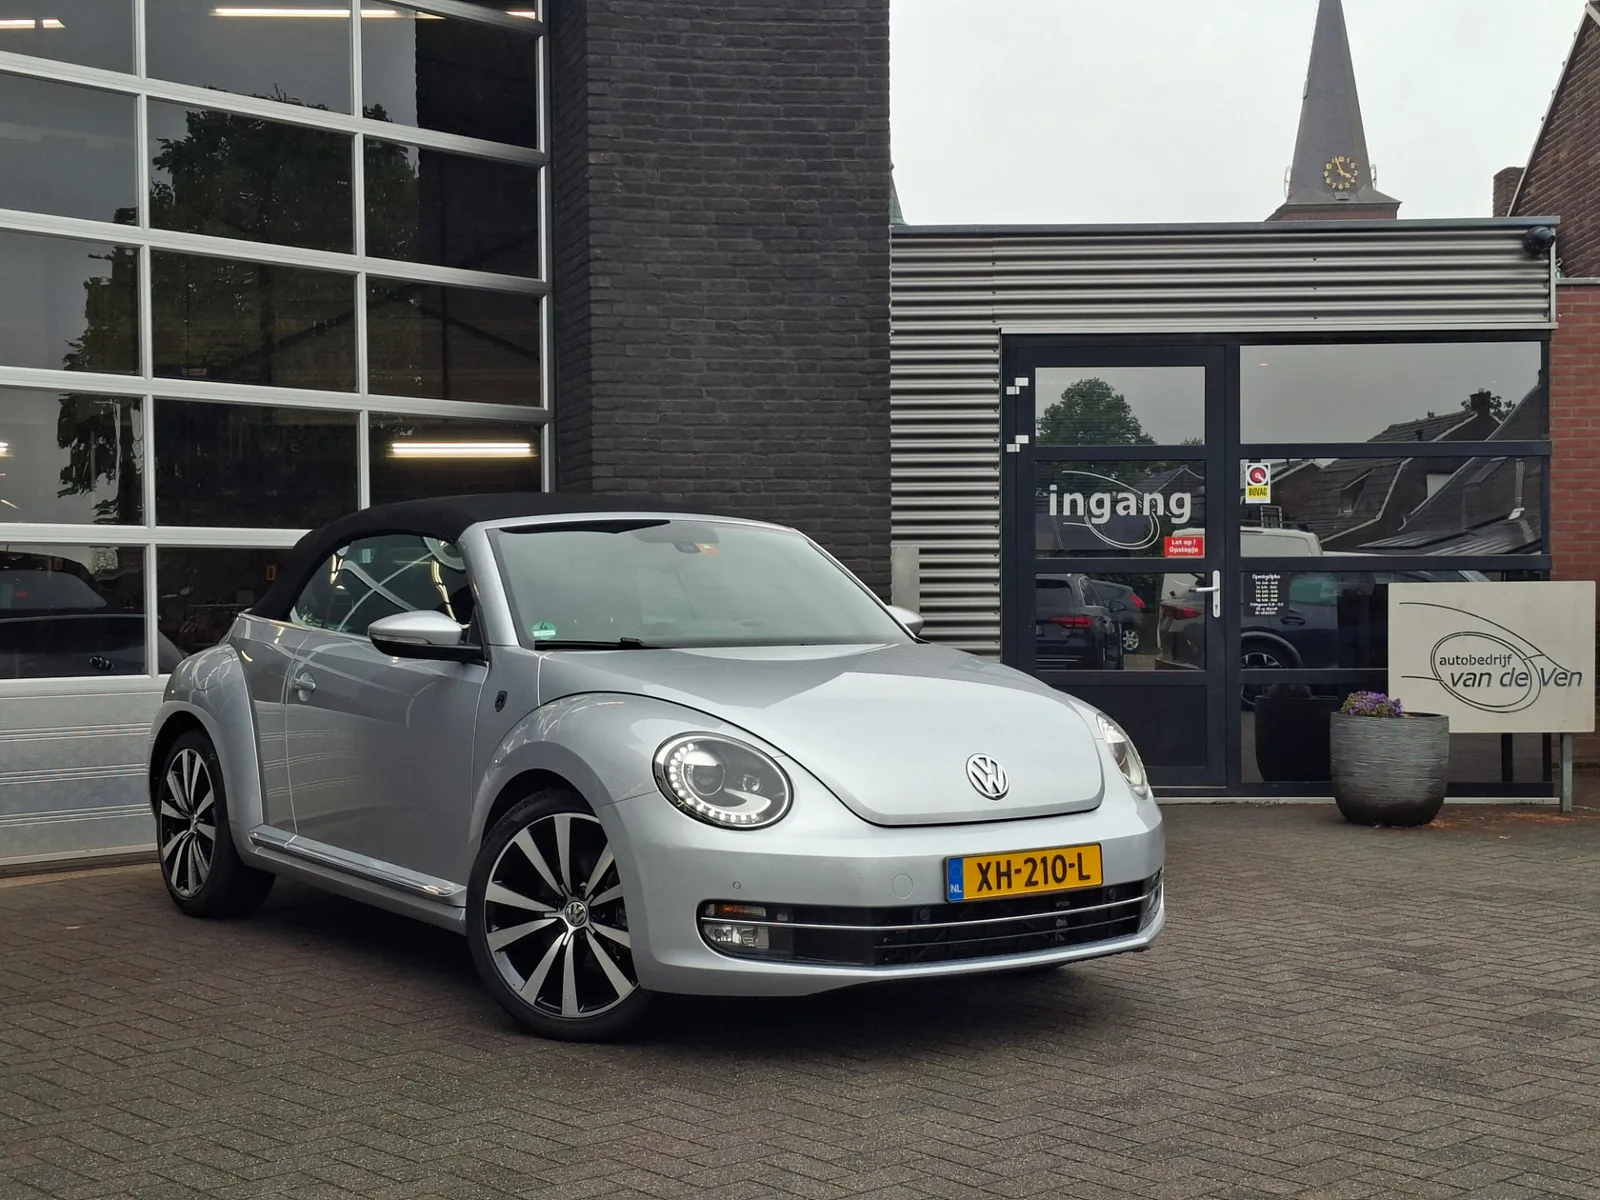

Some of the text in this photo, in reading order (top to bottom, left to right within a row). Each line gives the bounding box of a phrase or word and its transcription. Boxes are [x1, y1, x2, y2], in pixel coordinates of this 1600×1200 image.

[1248, 486, 1268, 497] BOVAG
[1049, 484, 1192, 524] ingang
[1439, 654, 1513, 667] autobedrijf
[1450, 667, 1583, 688] van de Ven
[977, 852, 1091, 892] XH-210-L
[950, 883, 962, 893] NL
